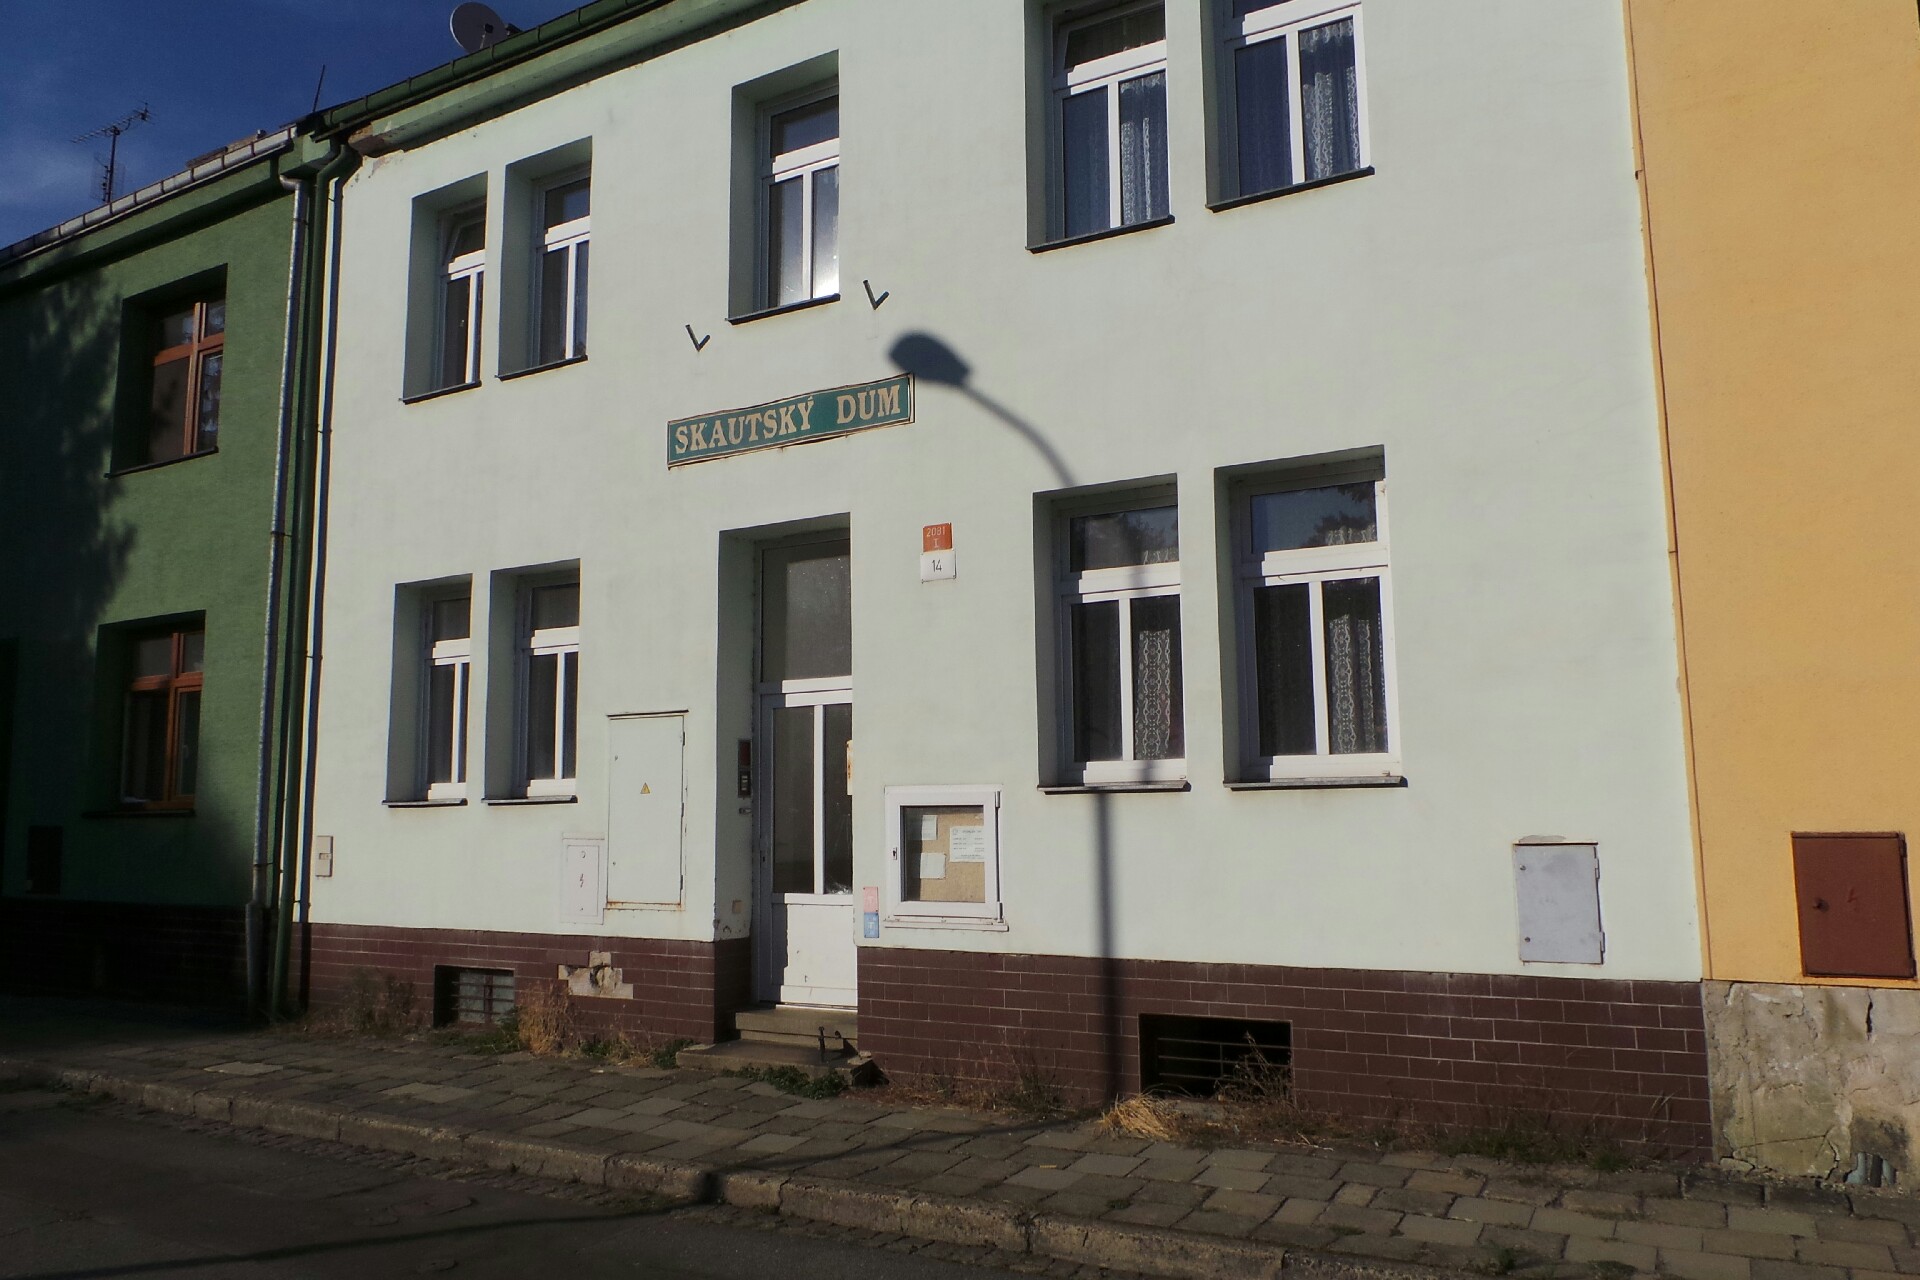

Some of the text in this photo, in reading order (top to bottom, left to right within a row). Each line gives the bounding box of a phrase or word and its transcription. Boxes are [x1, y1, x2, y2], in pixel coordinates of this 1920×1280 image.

[675, 385, 901, 454] SKAUTSKÝ DŮM
[927, 526, 945, 537] 2081
[932, 558, 942, 572] 14
